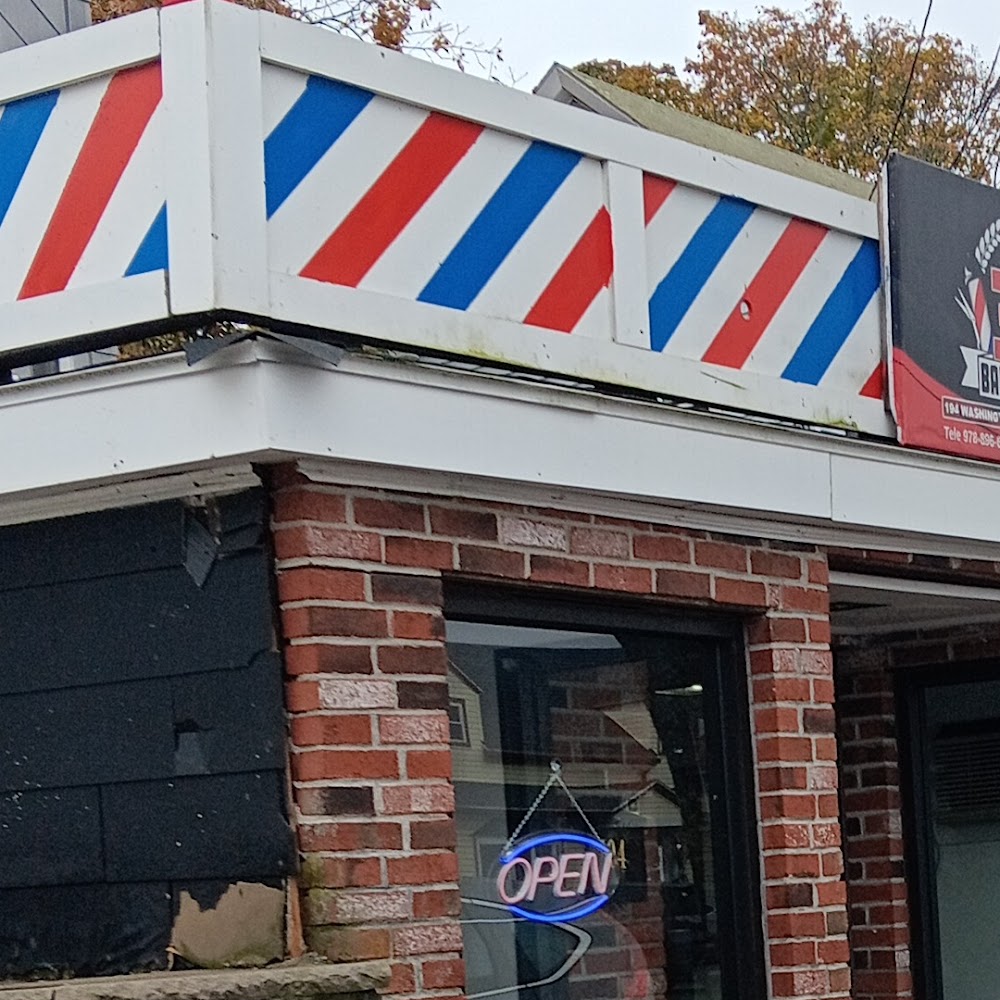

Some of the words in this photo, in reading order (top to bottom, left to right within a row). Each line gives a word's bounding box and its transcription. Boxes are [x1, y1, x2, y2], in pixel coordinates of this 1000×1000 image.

[944, 401, 960, 415] 194
[943, 425, 962, 442] Tele
[496, 851, 613, 904] OPEN
